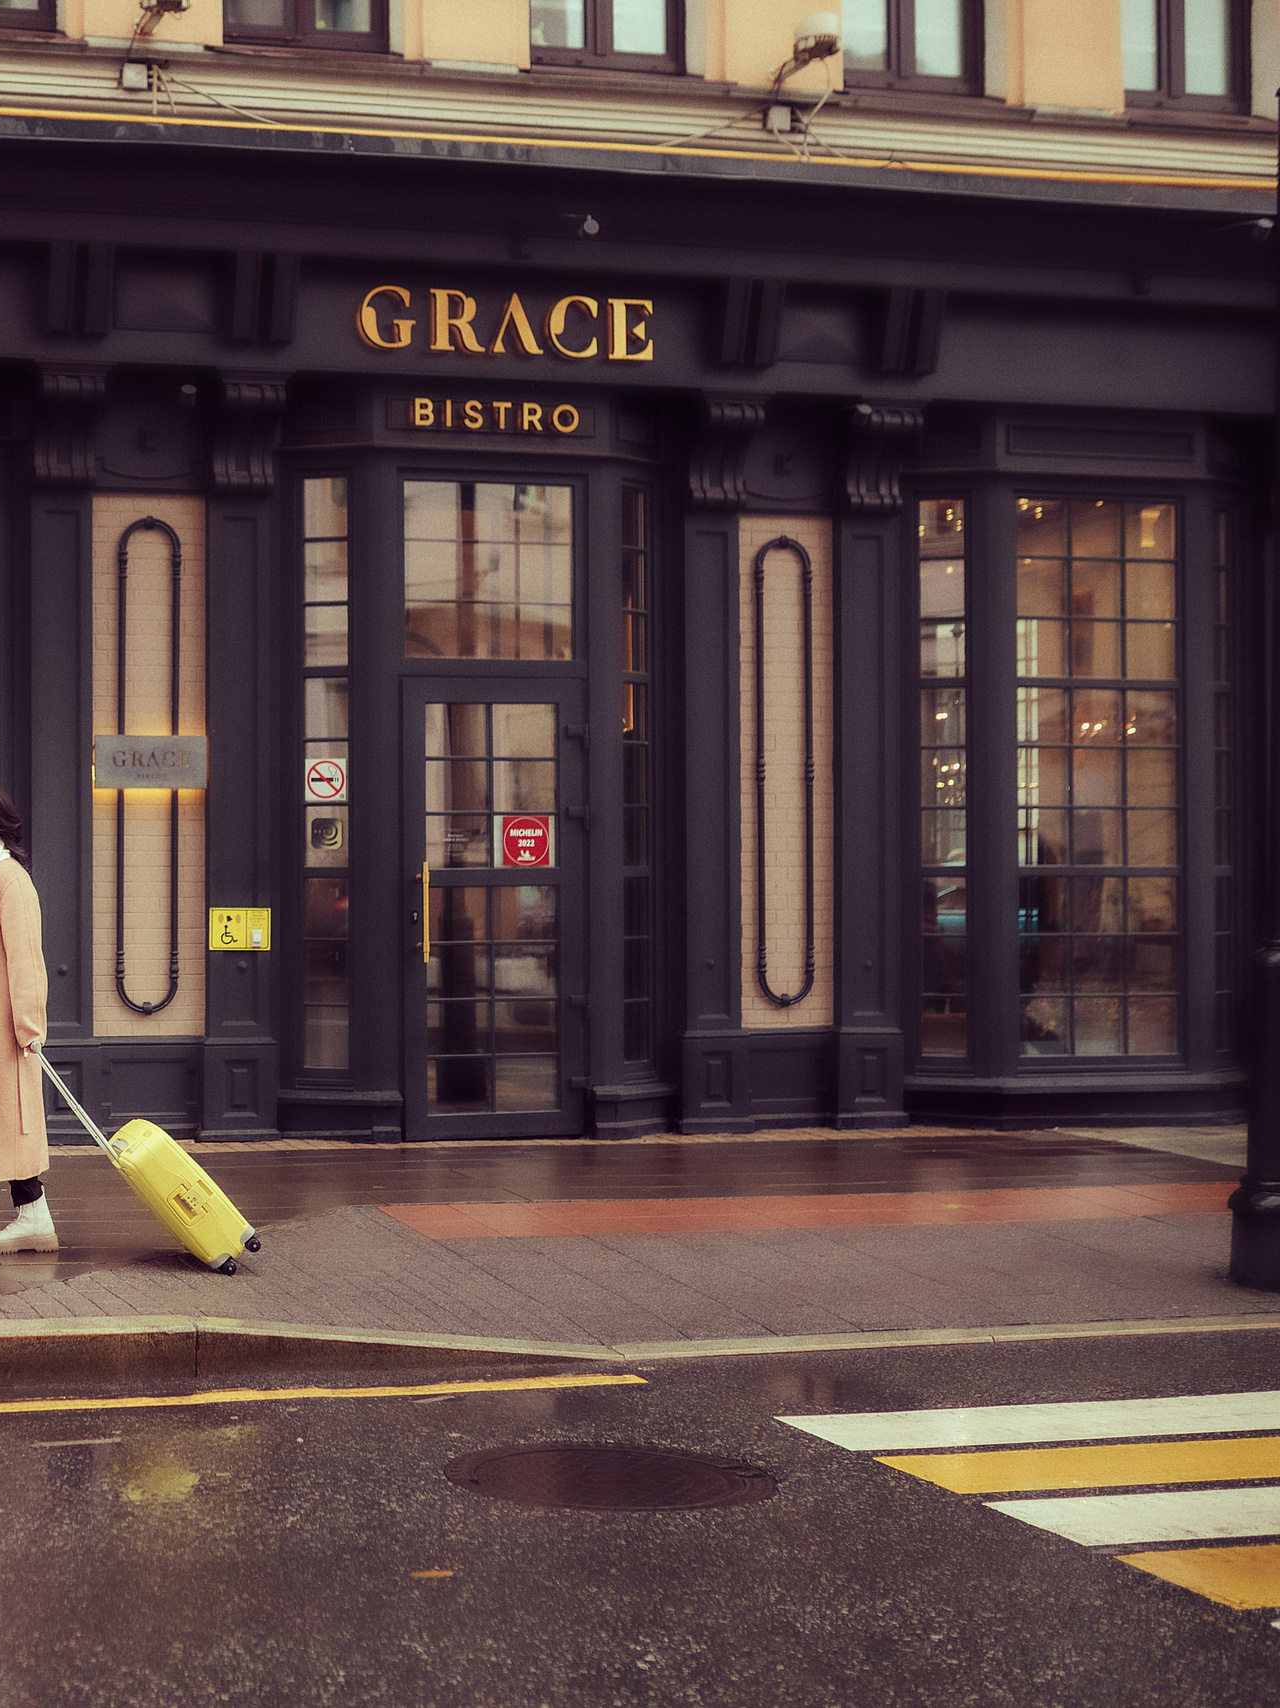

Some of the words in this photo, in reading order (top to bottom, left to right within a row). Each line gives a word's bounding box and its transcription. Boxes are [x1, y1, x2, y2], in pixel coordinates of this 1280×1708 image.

[359, 285, 654, 362] GRACE
[412, 398, 580, 433] BISTRO
[112, 750, 191, 768] GRACE
[509, 828, 543, 837] MICHELIN
[517, 838, 535, 847] 2022
